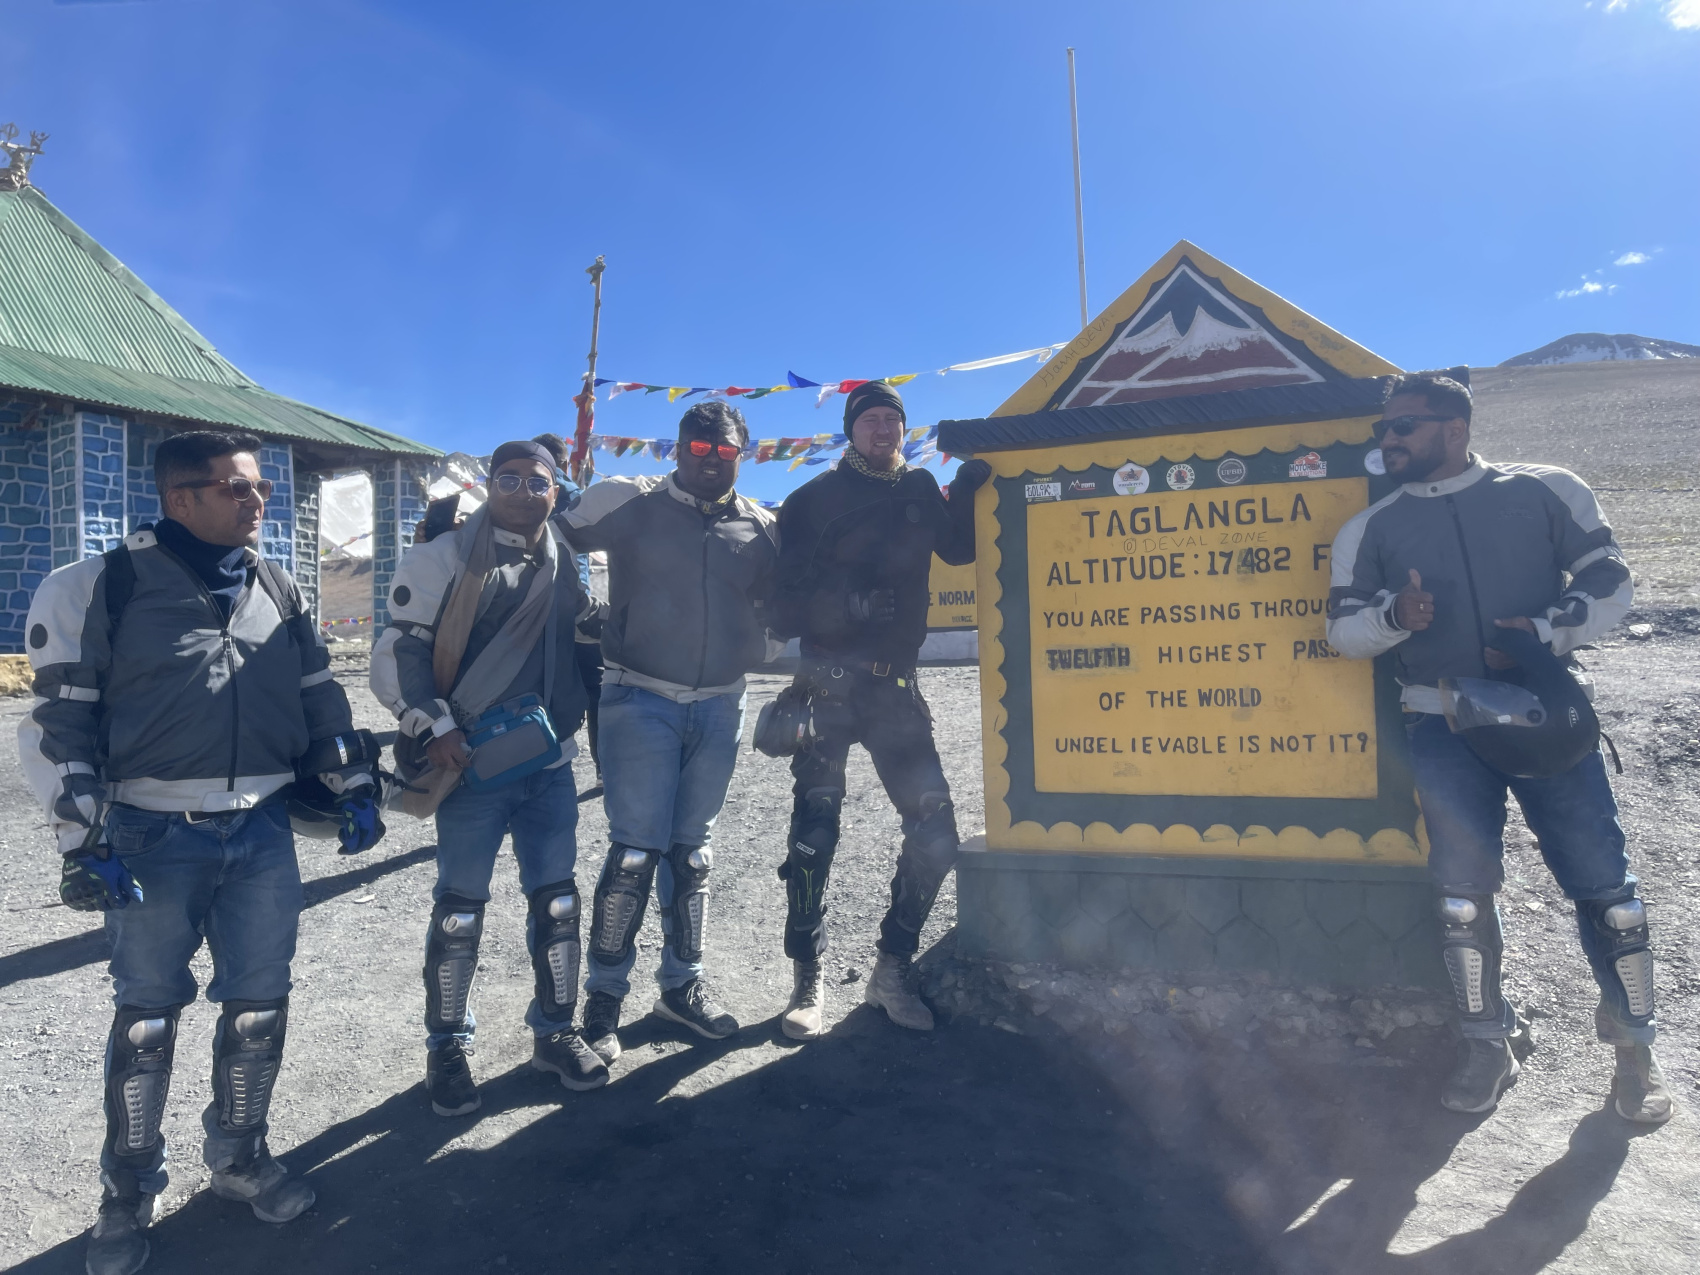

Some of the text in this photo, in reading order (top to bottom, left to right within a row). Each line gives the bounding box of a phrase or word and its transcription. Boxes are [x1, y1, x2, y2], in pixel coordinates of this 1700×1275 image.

[1081, 493, 1312, 538] TAGLANGLA
[1143, 535, 1208, 553] DEVAL
[1220, 531, 1269, 545] ZONE
[1313, 544, 1332, 572] F
[1043, 610, 1085, 628] YOU
[1090, 608, 1130, 626] ARE
[1140, 602, 1241, 624] PASSING
[1046, 647, 1130, 671] TWELFTH
[1158, 643, 1267, 664] HIGHEST
[1099, 687, 1262, 711] OF THE WORLD
[1055, 736, 1227, 754] UNBELIEVABLE
[1239, 735, 1260, 753] IS
[1270, 734, 1317, 753] NOT
